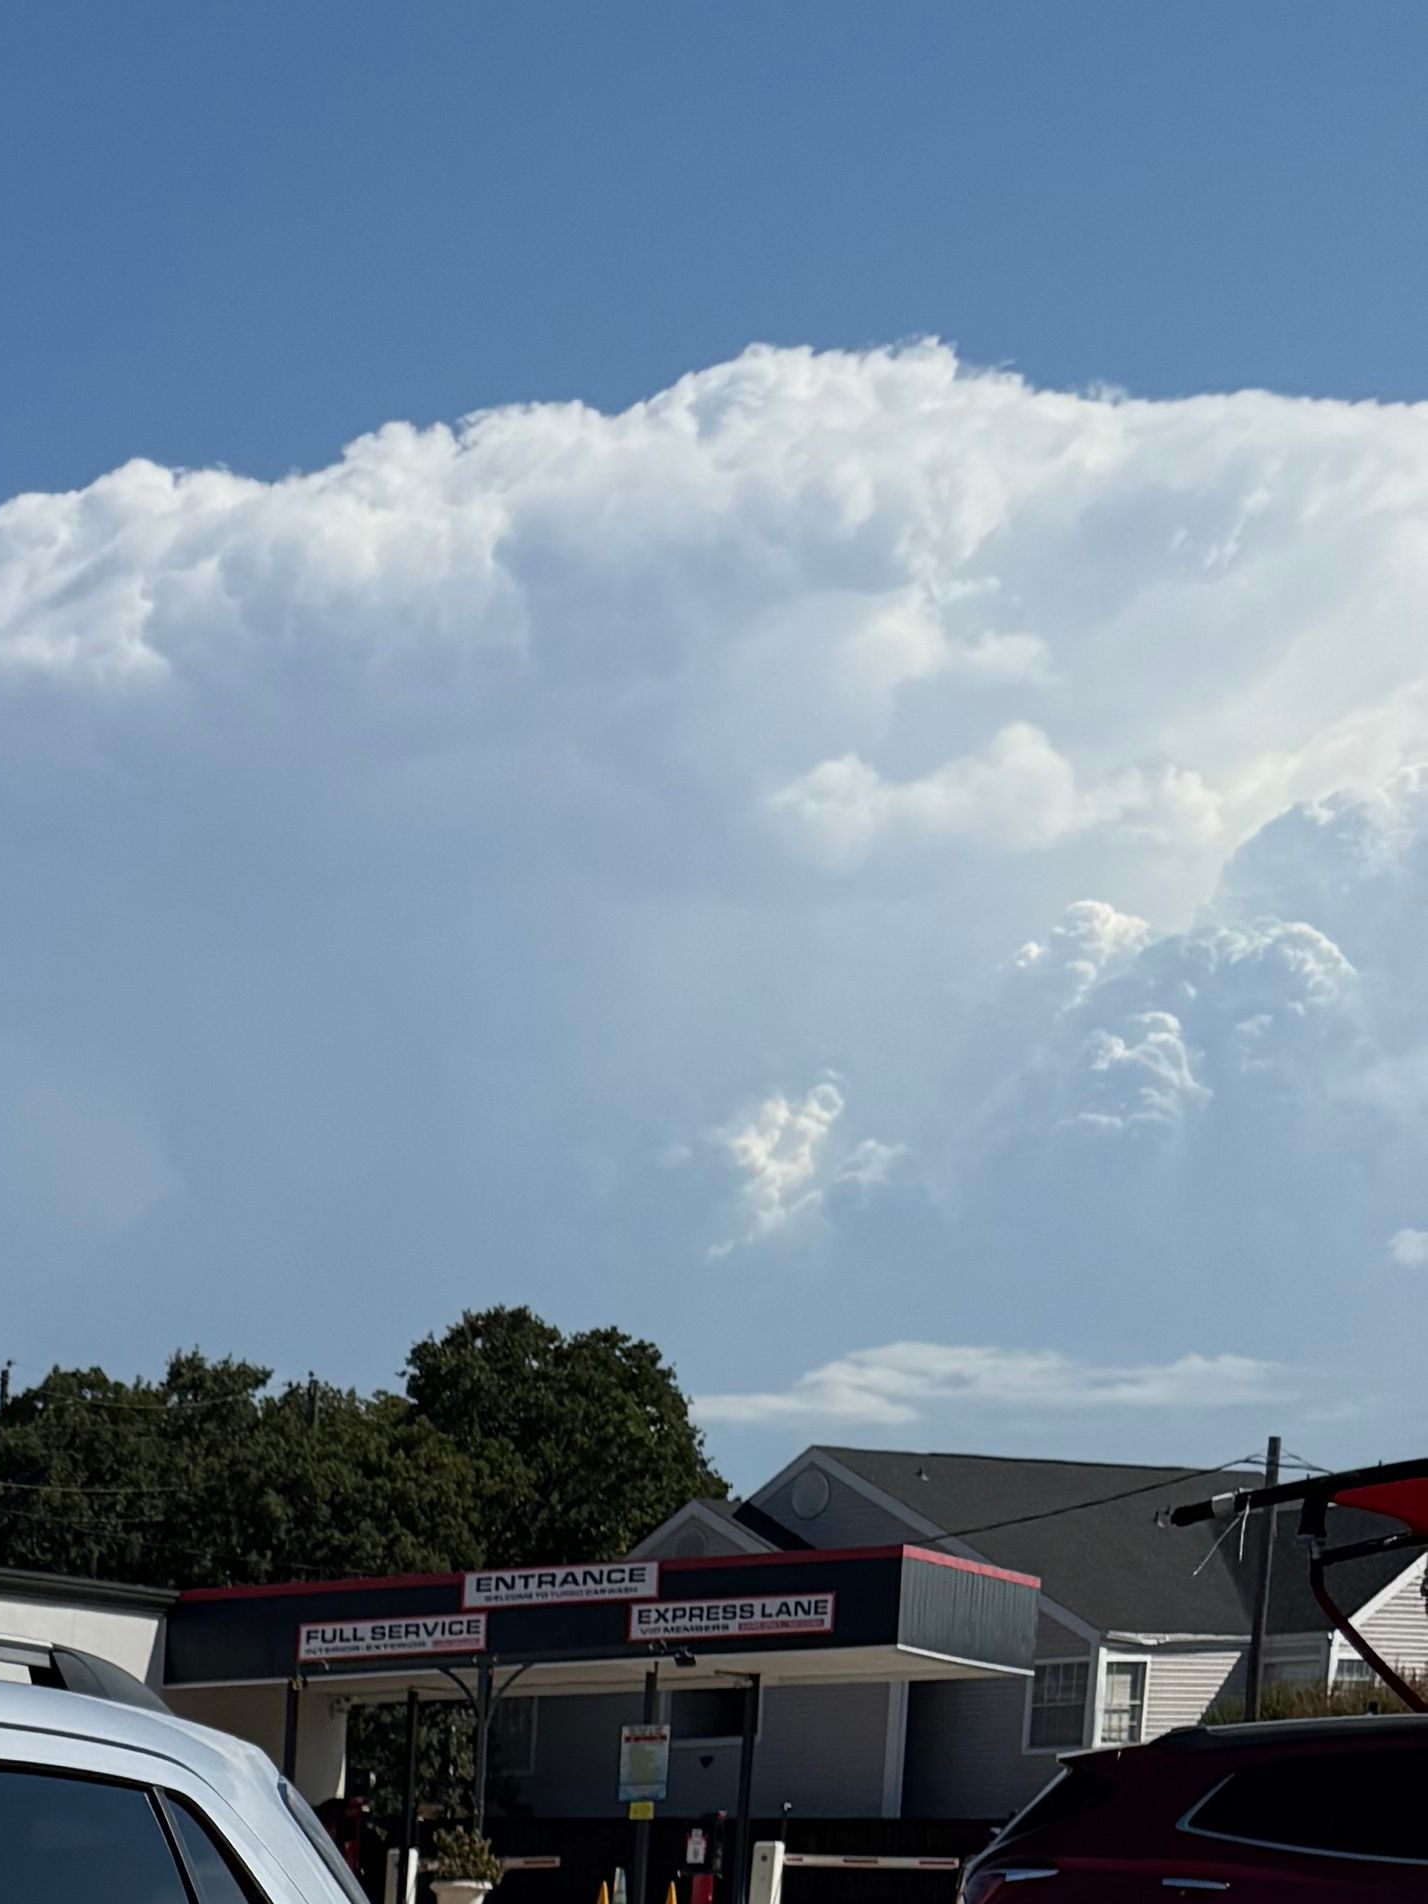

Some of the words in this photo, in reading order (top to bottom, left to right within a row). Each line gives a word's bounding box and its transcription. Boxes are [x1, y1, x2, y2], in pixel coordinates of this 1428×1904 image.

[476, 1567, 646, 1593] ENTRANCE
[638, 1604, 754, 1625] EXPRESS
[761, 1599, 829, 1618] LANE
[306, 1627, 365, 1645] FULL
[370, 1619, 481, 1641] SERVICE
[663, 1622, 729, 1635] MEMBERS
